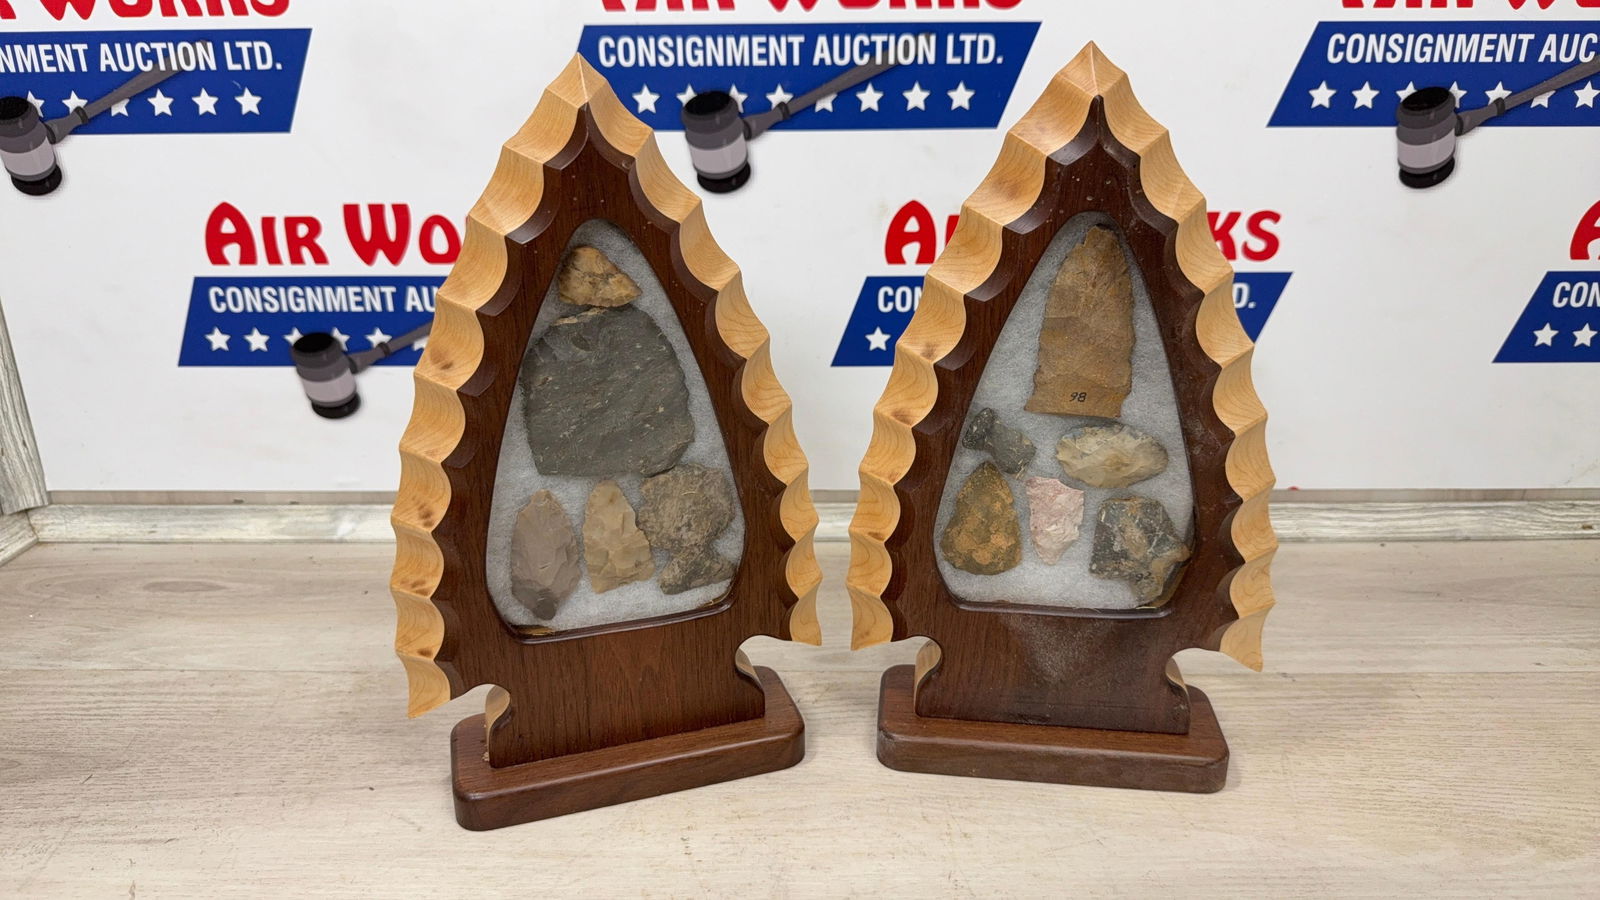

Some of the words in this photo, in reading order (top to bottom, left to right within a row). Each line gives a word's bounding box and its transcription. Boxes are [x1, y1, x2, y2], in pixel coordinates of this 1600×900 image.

[0, 43, 88, 72] NMENT
[100, 42, 217, 72] AUCTION
[225, 40, 283, 71] LTD.
[599, 36, 804, 67] CONSIGNMENT
[812, 34, 936, 66] AUCTION
[946, 33, 1004, 64] LTD.
[1327, 33, 1535, 64] CONSIGNMENT
[1538, 33, 1598, 63] AUC
[342, 203, 469, 267] WO
[209, 286, 396, 314] CONSIGNMENT
[1069, 391, 1087, 403] 98
